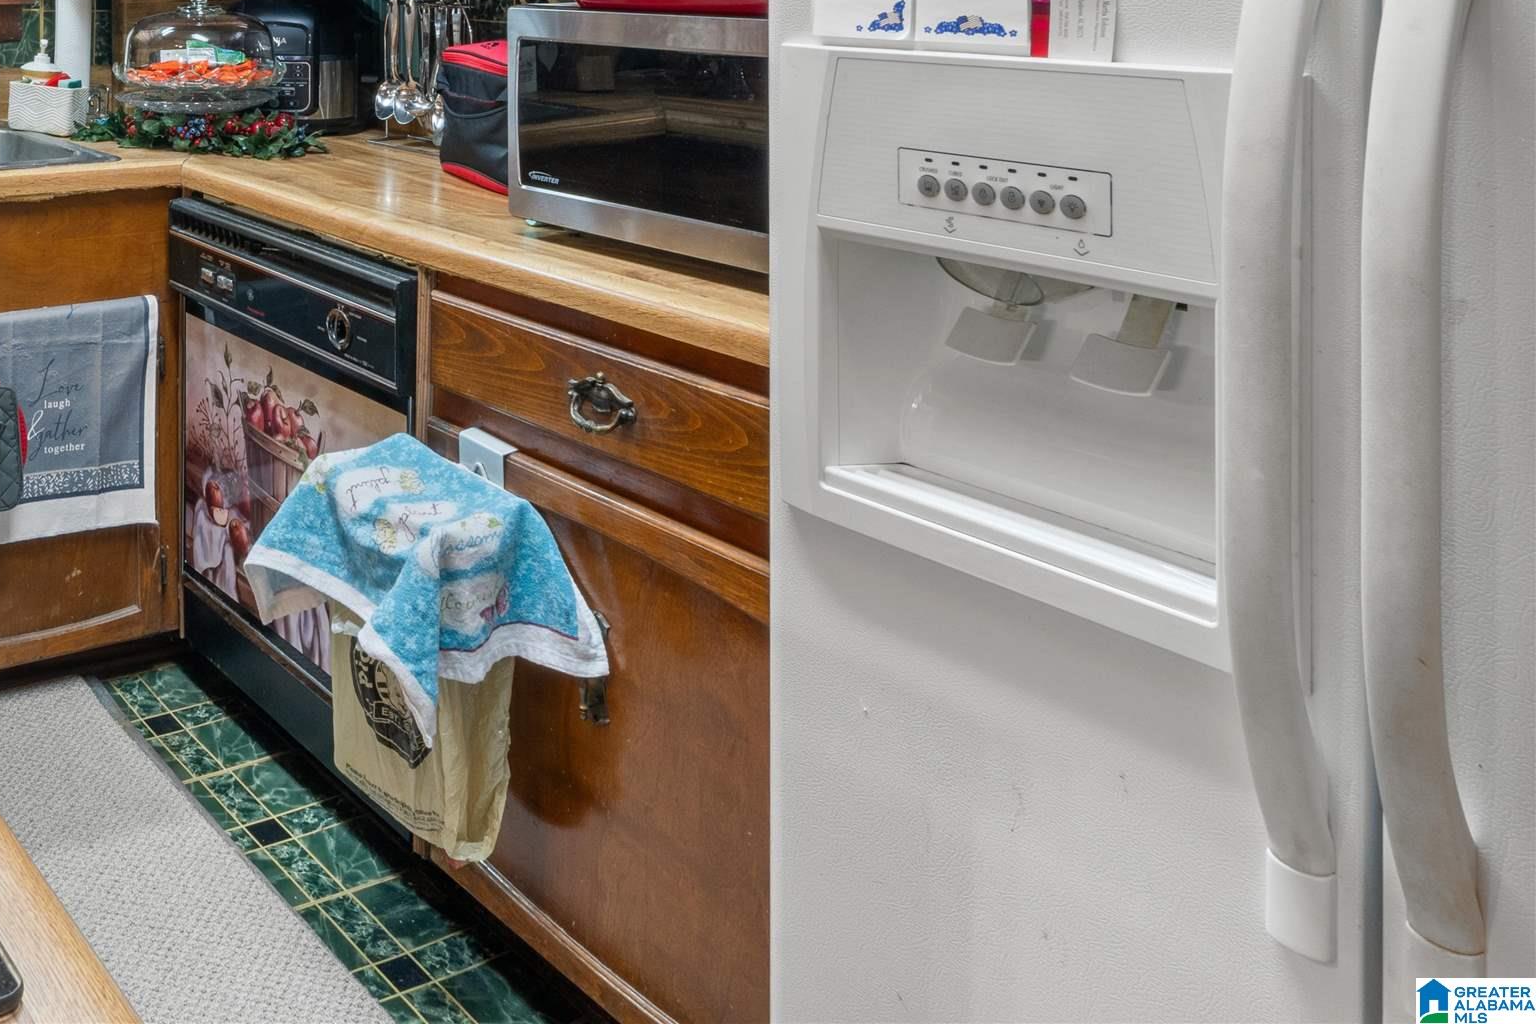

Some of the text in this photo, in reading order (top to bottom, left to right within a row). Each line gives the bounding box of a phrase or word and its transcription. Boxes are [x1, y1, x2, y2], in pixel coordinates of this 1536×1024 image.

[531, 173, 560, 185] INVERTER
[28, 358, 84, 408] Love
[44, 398, 71, 409] laugh
[27, 409, 45, 440] &
[44, 442, 85, 455] together
